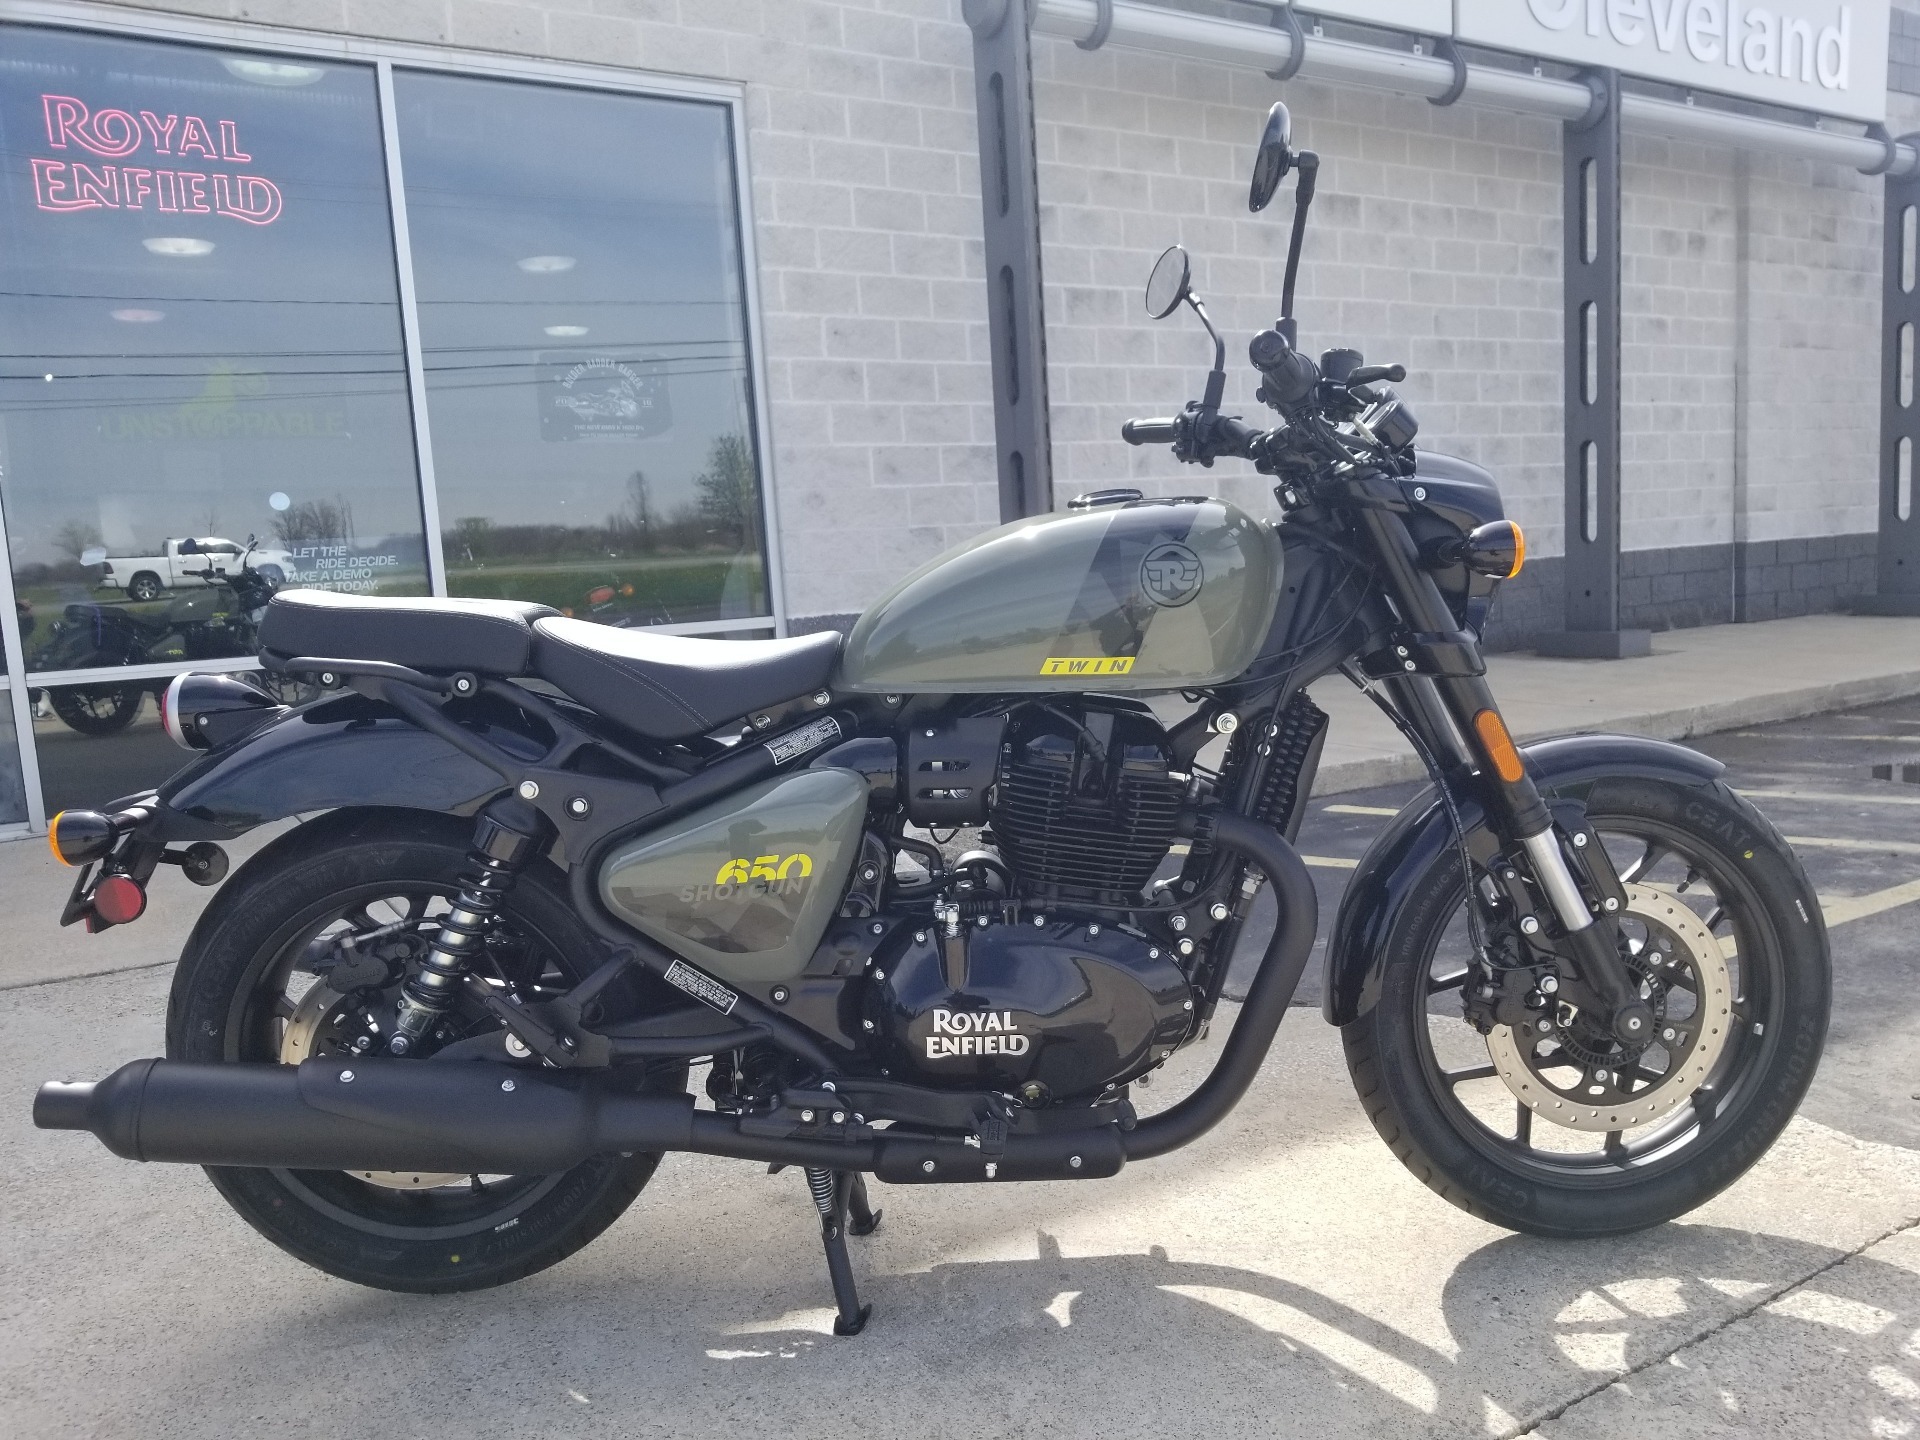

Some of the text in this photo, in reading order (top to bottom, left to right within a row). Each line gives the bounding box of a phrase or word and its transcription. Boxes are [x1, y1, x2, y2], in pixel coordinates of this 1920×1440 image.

[41, 94, 252, 162] ROYAL
[30, 158, 283, 225] ENFIELD
[292, 545, 347, 559] LET THE
[315, 555, 399, 569] RIDE DECIDE.
[284, 568, 372, 582] TAKE A DEMO
[335, 580, 379, 592] TODAY.
[1050, 659, 1129, 673] TWIN
[1685, 801, 1751, 847] CEAT
[715, 853, 813, 885] 650
[932, 1009, 1018, 1035] ROYAL
[925, 1034, 1030, 1059] ENFIELD
